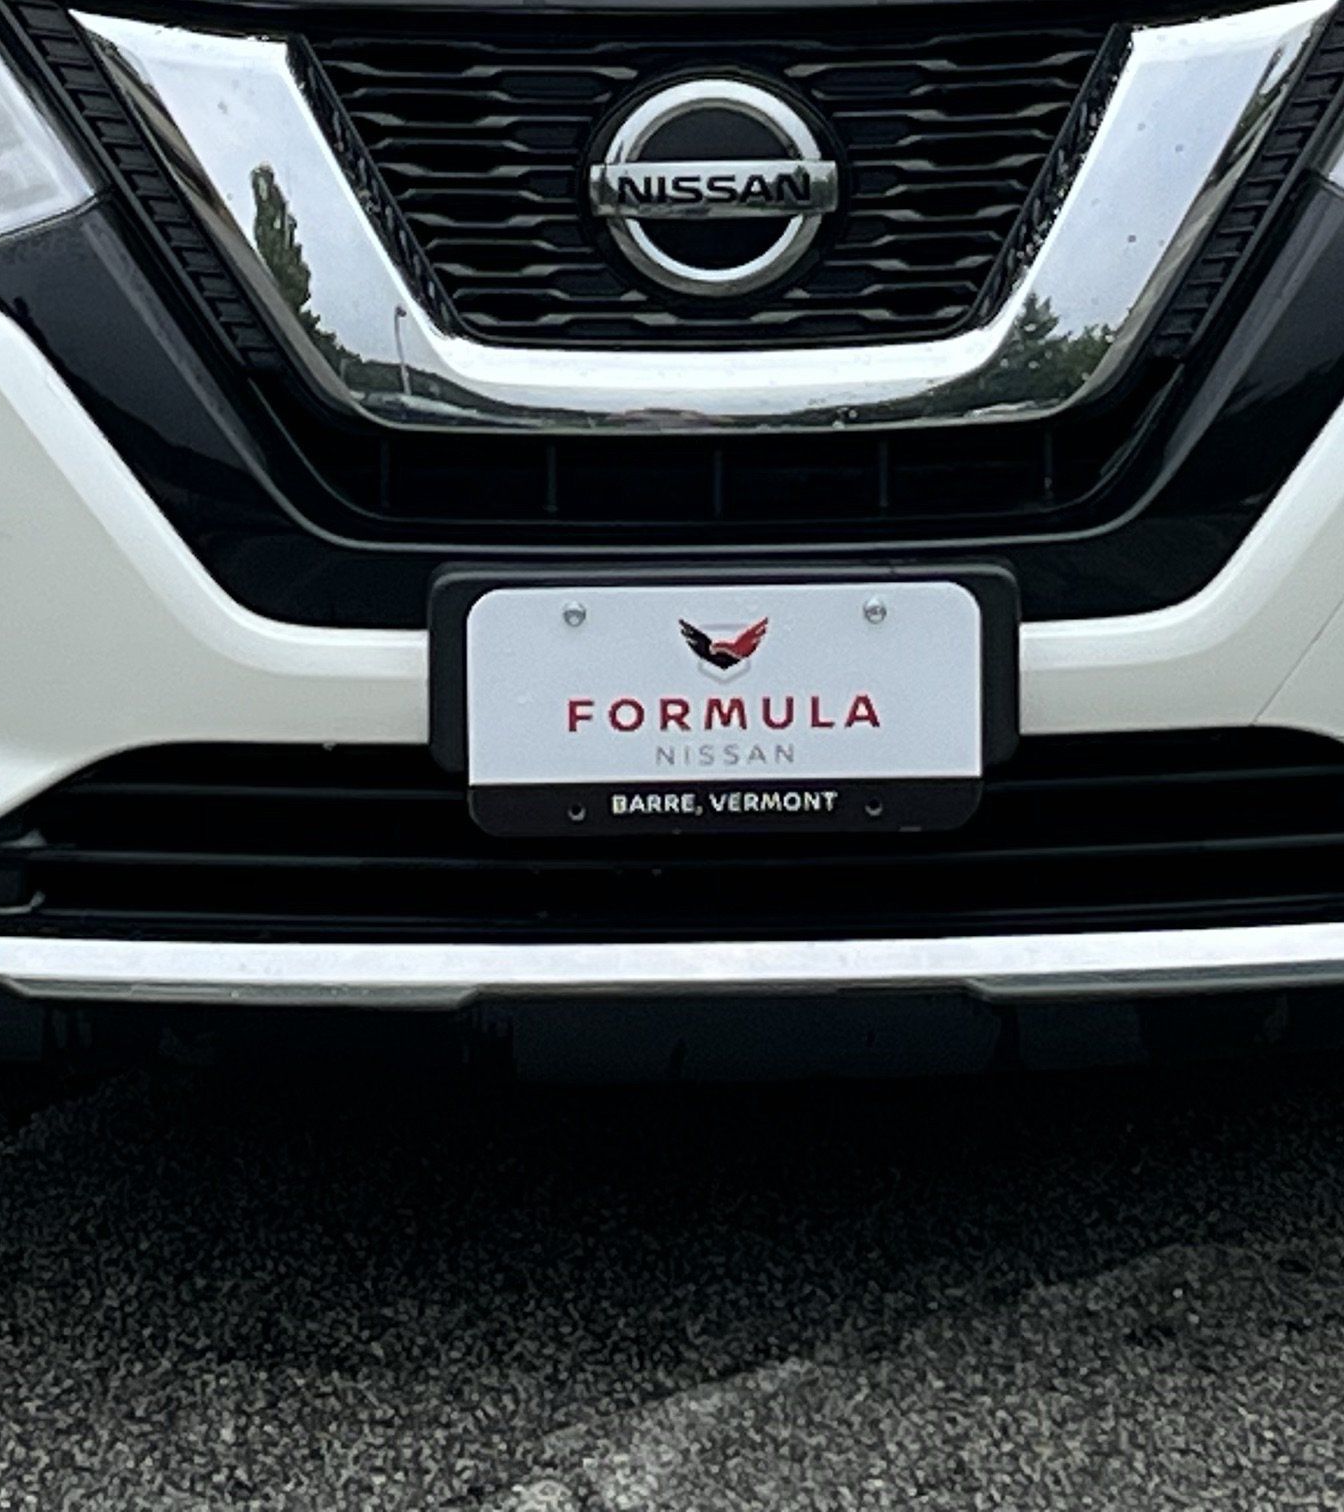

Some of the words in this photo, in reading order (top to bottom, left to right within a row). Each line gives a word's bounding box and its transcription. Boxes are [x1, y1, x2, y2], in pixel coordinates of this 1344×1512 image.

[617, 172, 811, 205] NISSAN
[567, 694, 881, 733] FORMULA
[656, 743, 795, 766] NISSAN
[611, 794, 703, 816] BARRE,
[709, 791, 838, 813] VERMONT
